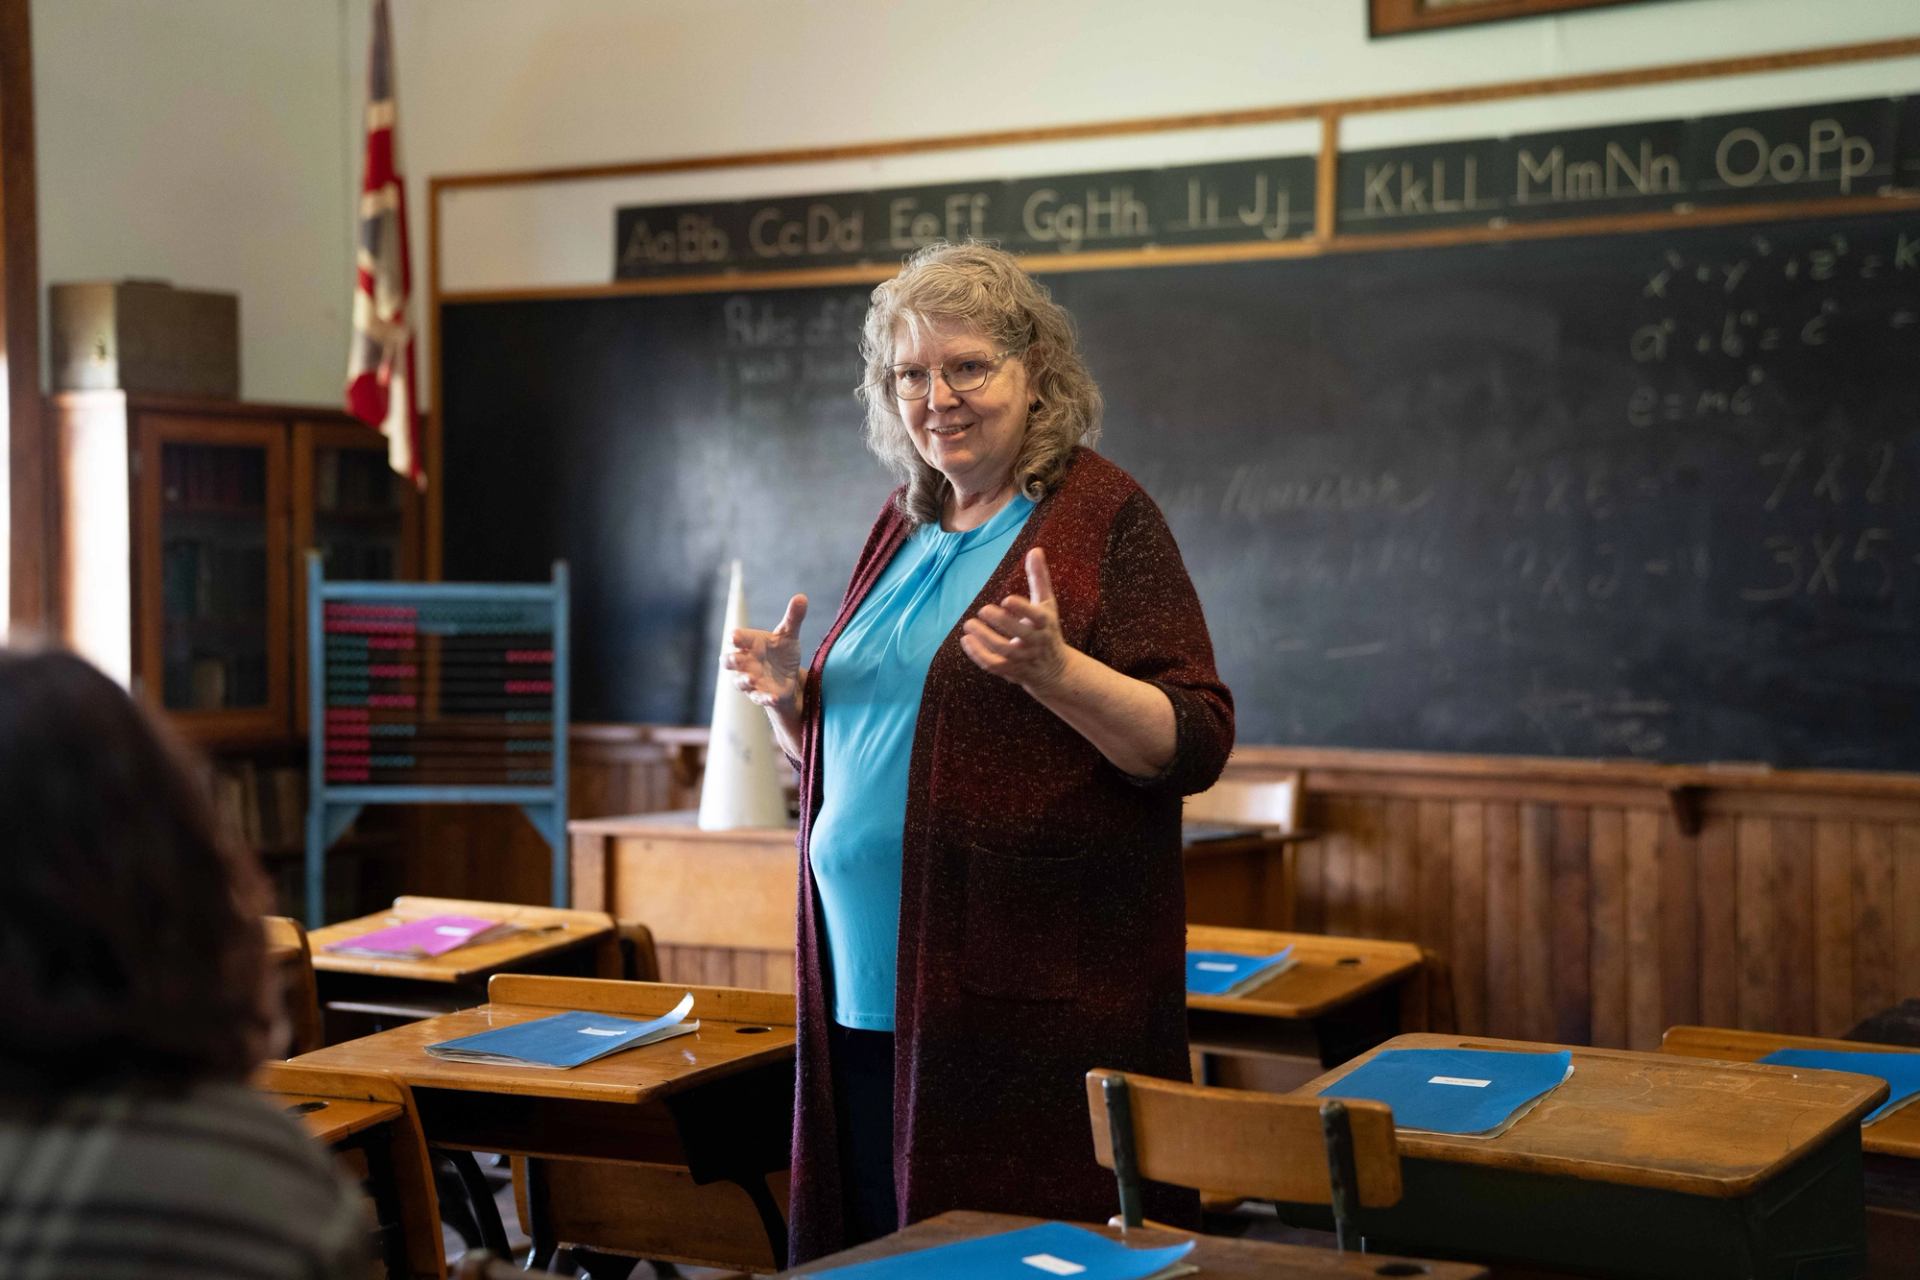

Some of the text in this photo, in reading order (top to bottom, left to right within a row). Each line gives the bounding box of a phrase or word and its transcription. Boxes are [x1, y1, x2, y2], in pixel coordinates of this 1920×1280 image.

[1517, 138, 1681, 205] MmNn
[1715, 118, 1875, 194] OoPp
[624, 215, 730, 264] AaBb
[748, 203, 865, 259] CcDd
[1022, 186, 1149, 253] GgHh
